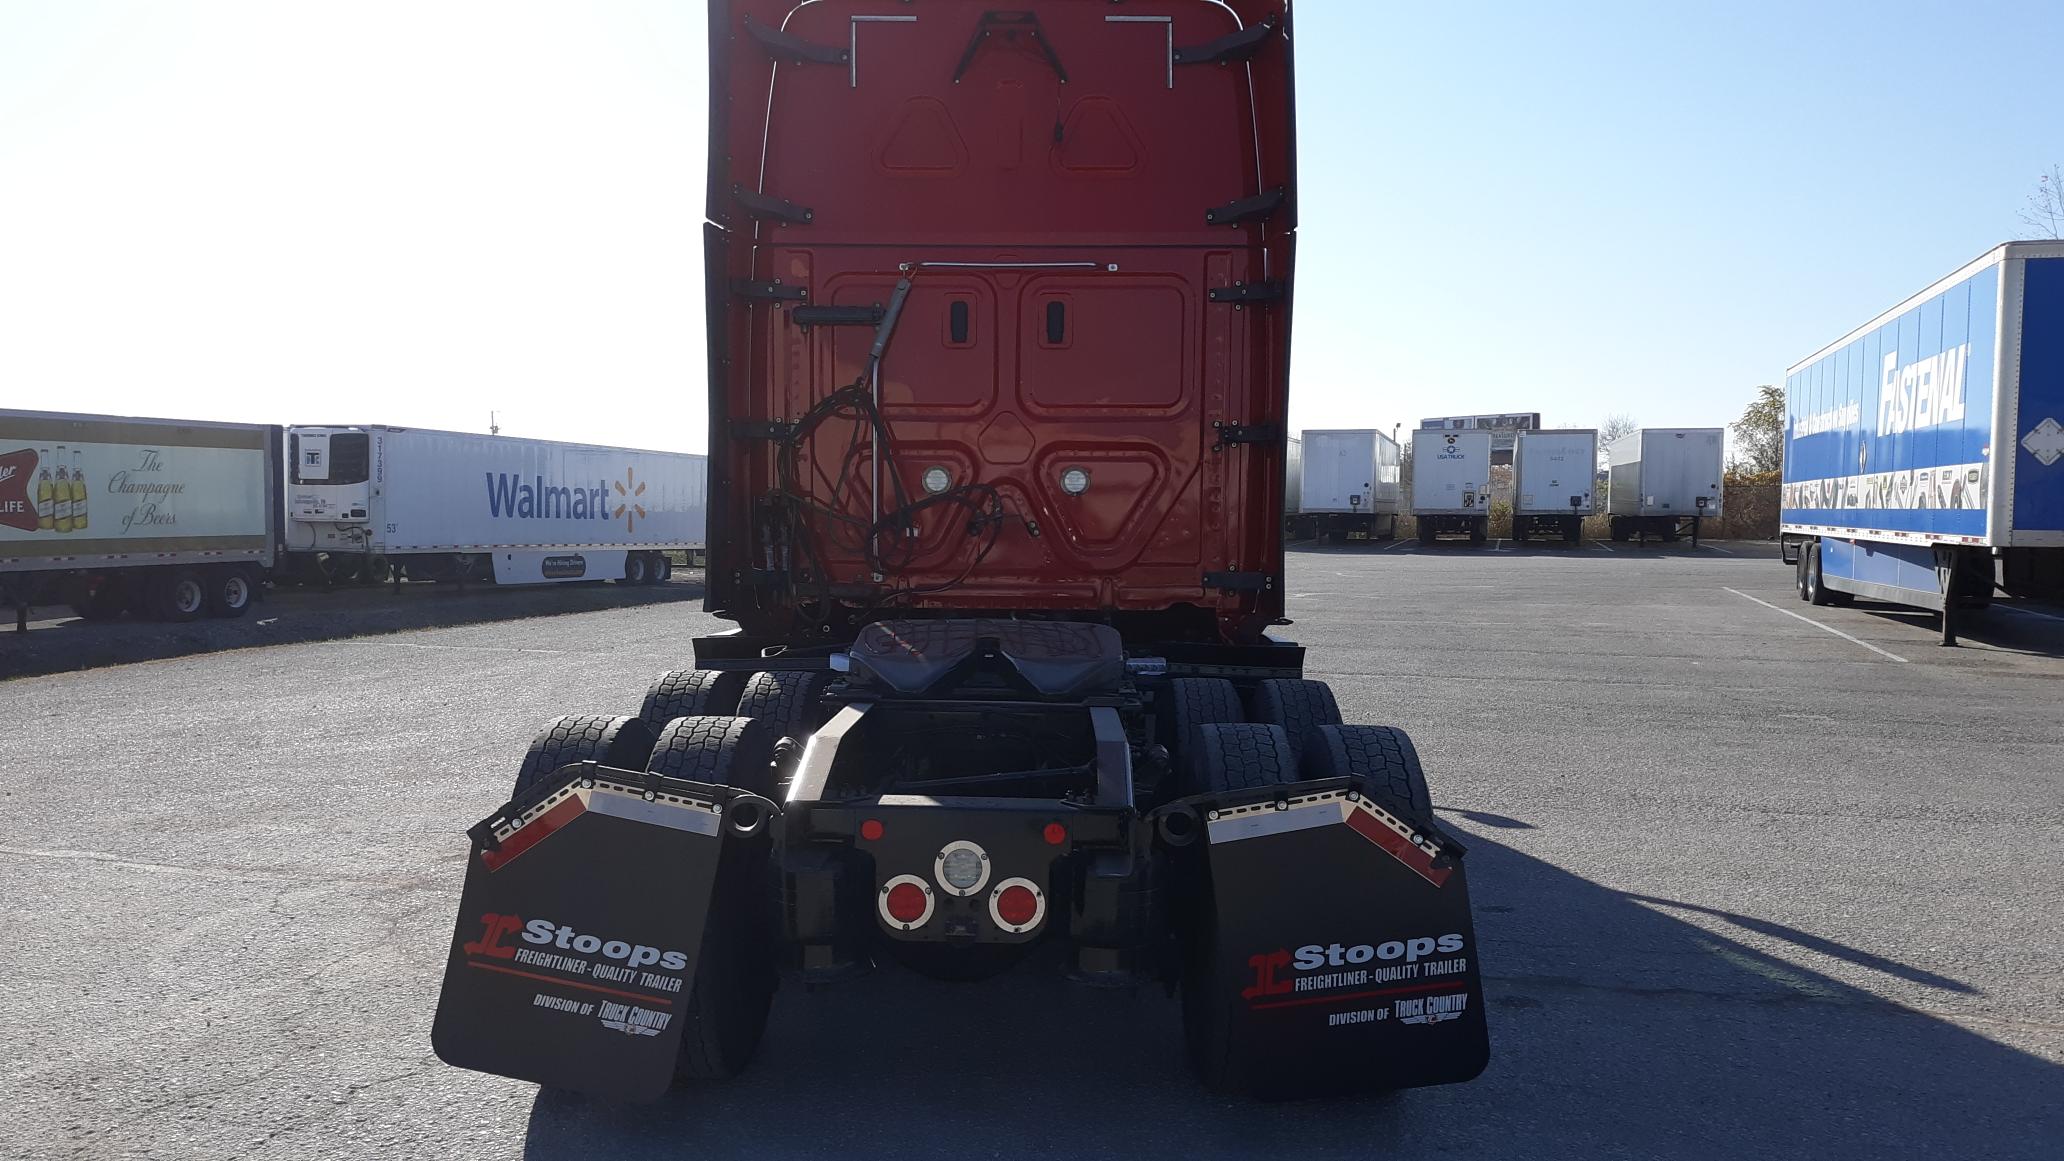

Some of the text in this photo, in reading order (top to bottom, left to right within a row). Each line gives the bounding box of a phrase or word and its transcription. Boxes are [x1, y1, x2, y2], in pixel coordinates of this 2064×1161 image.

[1877, 343, 1966, 437] FASTENAL
[131, 449, 163, 472] The
[107, 470, 186, 504] Champagne
[486, 472, 609, 520] Walmart
[120, 502, 177, 535] of Beers
[521, 919, 688, 970] Stoops
[1292, 933, 1464, 970] Stoops
[639, 972, 683, 993] TRAILER
[1424, 958, 1467, 977] TRAILER
[533, 993, 672, 1031] DIVISION OF TRUCK COUNTRY
[1329, 993, 1468, 1026] DIVISION OF TRUCK COUNTRY
